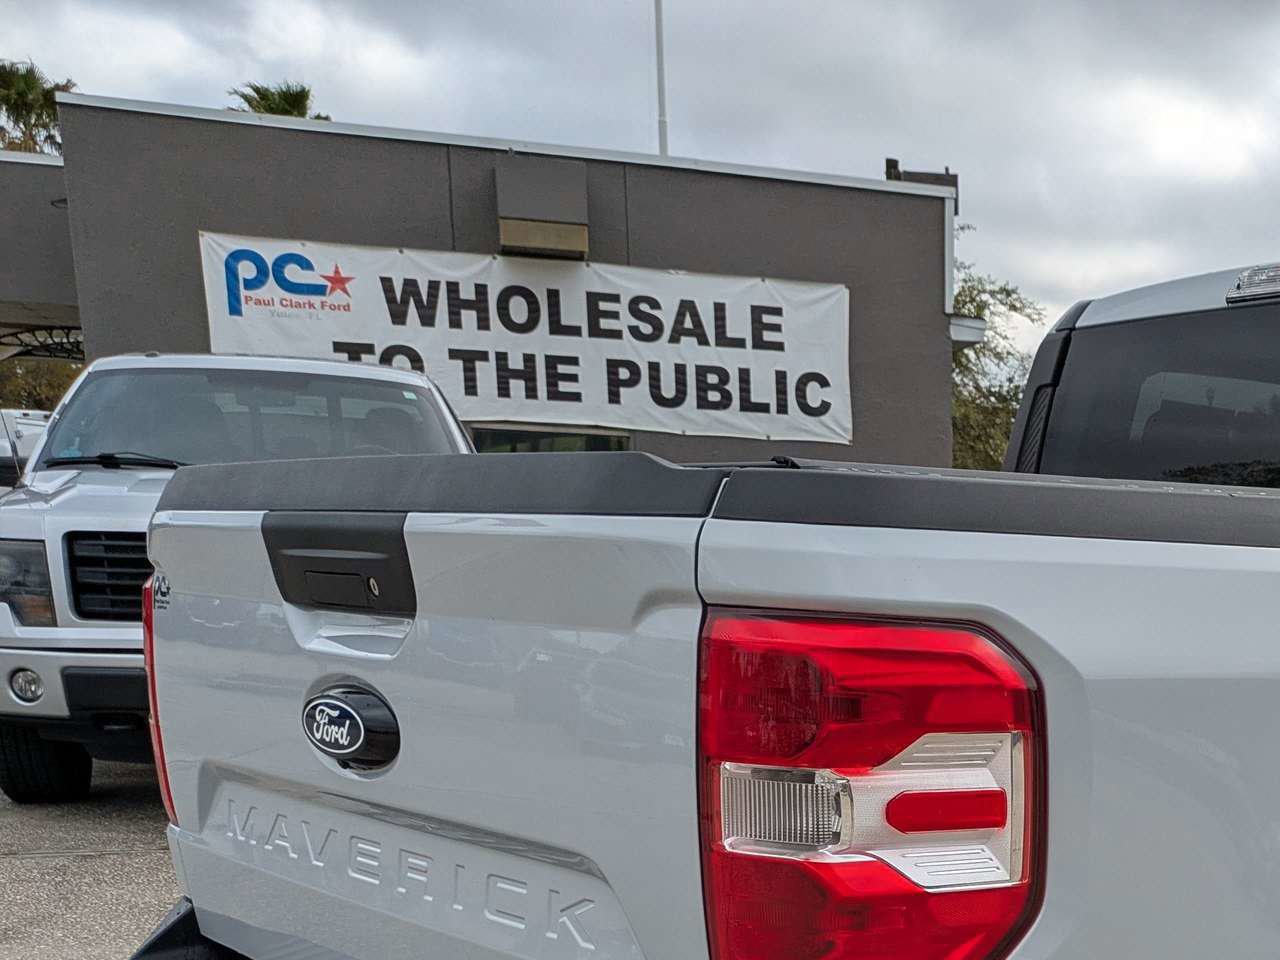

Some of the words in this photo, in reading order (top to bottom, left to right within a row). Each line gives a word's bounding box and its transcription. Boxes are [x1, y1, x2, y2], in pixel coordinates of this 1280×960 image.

[244, 295, 275, 308] Paul
[279, 297, 317, 311] Clark
[320, 300, 352, 313] Ford
[379, 276, 786, 352] WHOLESALE
[332, 340, 425, 374] TO
[447, 348, 583, 403] THE
[605, 358, 832, 418] PUBLIC
[313, 705, 351, 746] Ford
[226, 799, 597, 951] MAVERICK
